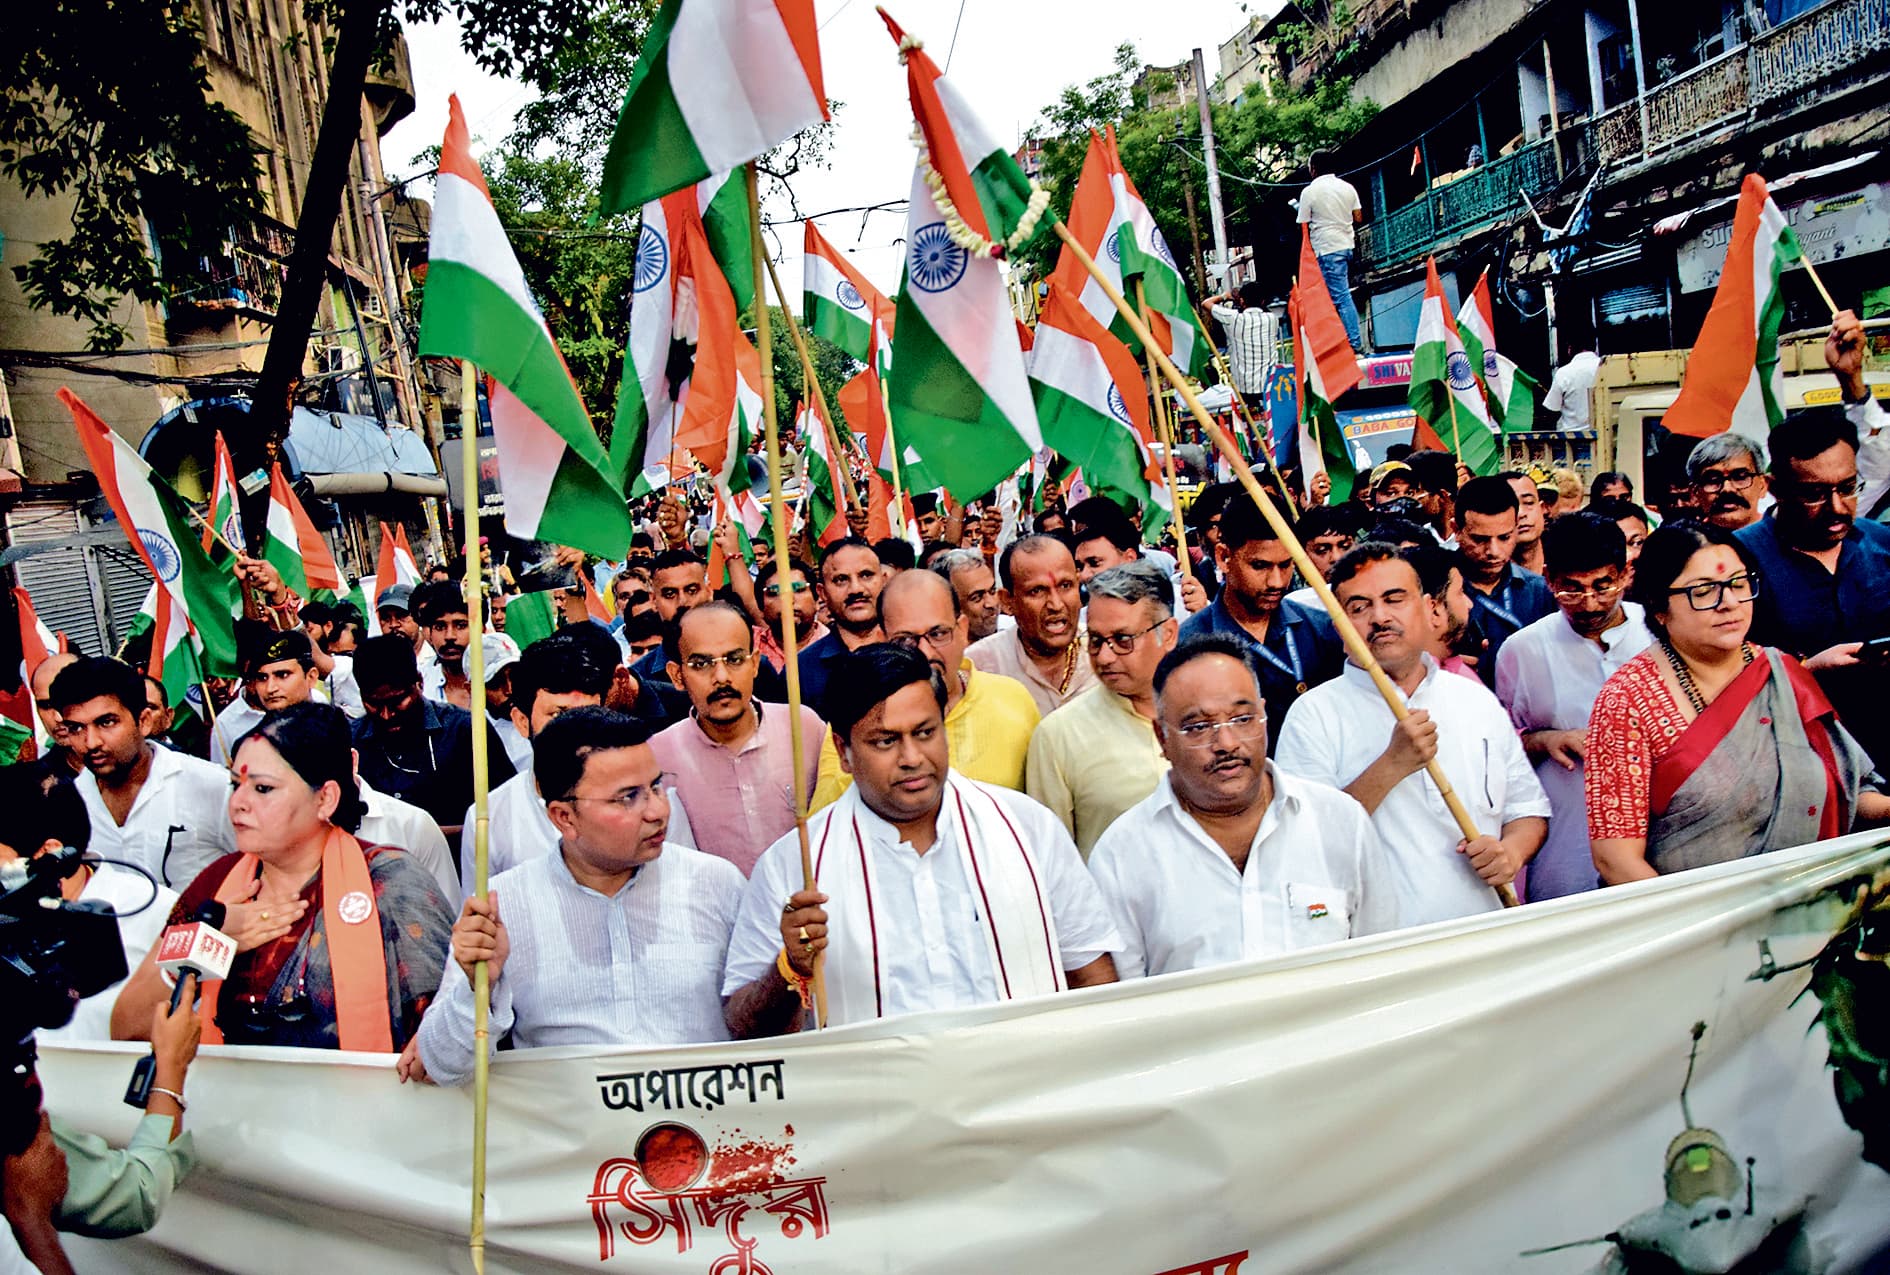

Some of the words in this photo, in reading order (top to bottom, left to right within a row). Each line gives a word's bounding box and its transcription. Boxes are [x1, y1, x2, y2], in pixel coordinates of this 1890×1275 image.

[1374, 361, 1413, 378] SHIVA
[1353, 422, 1389, 434] BABA
[597, 1059, 785, 1112] অপারেশন
